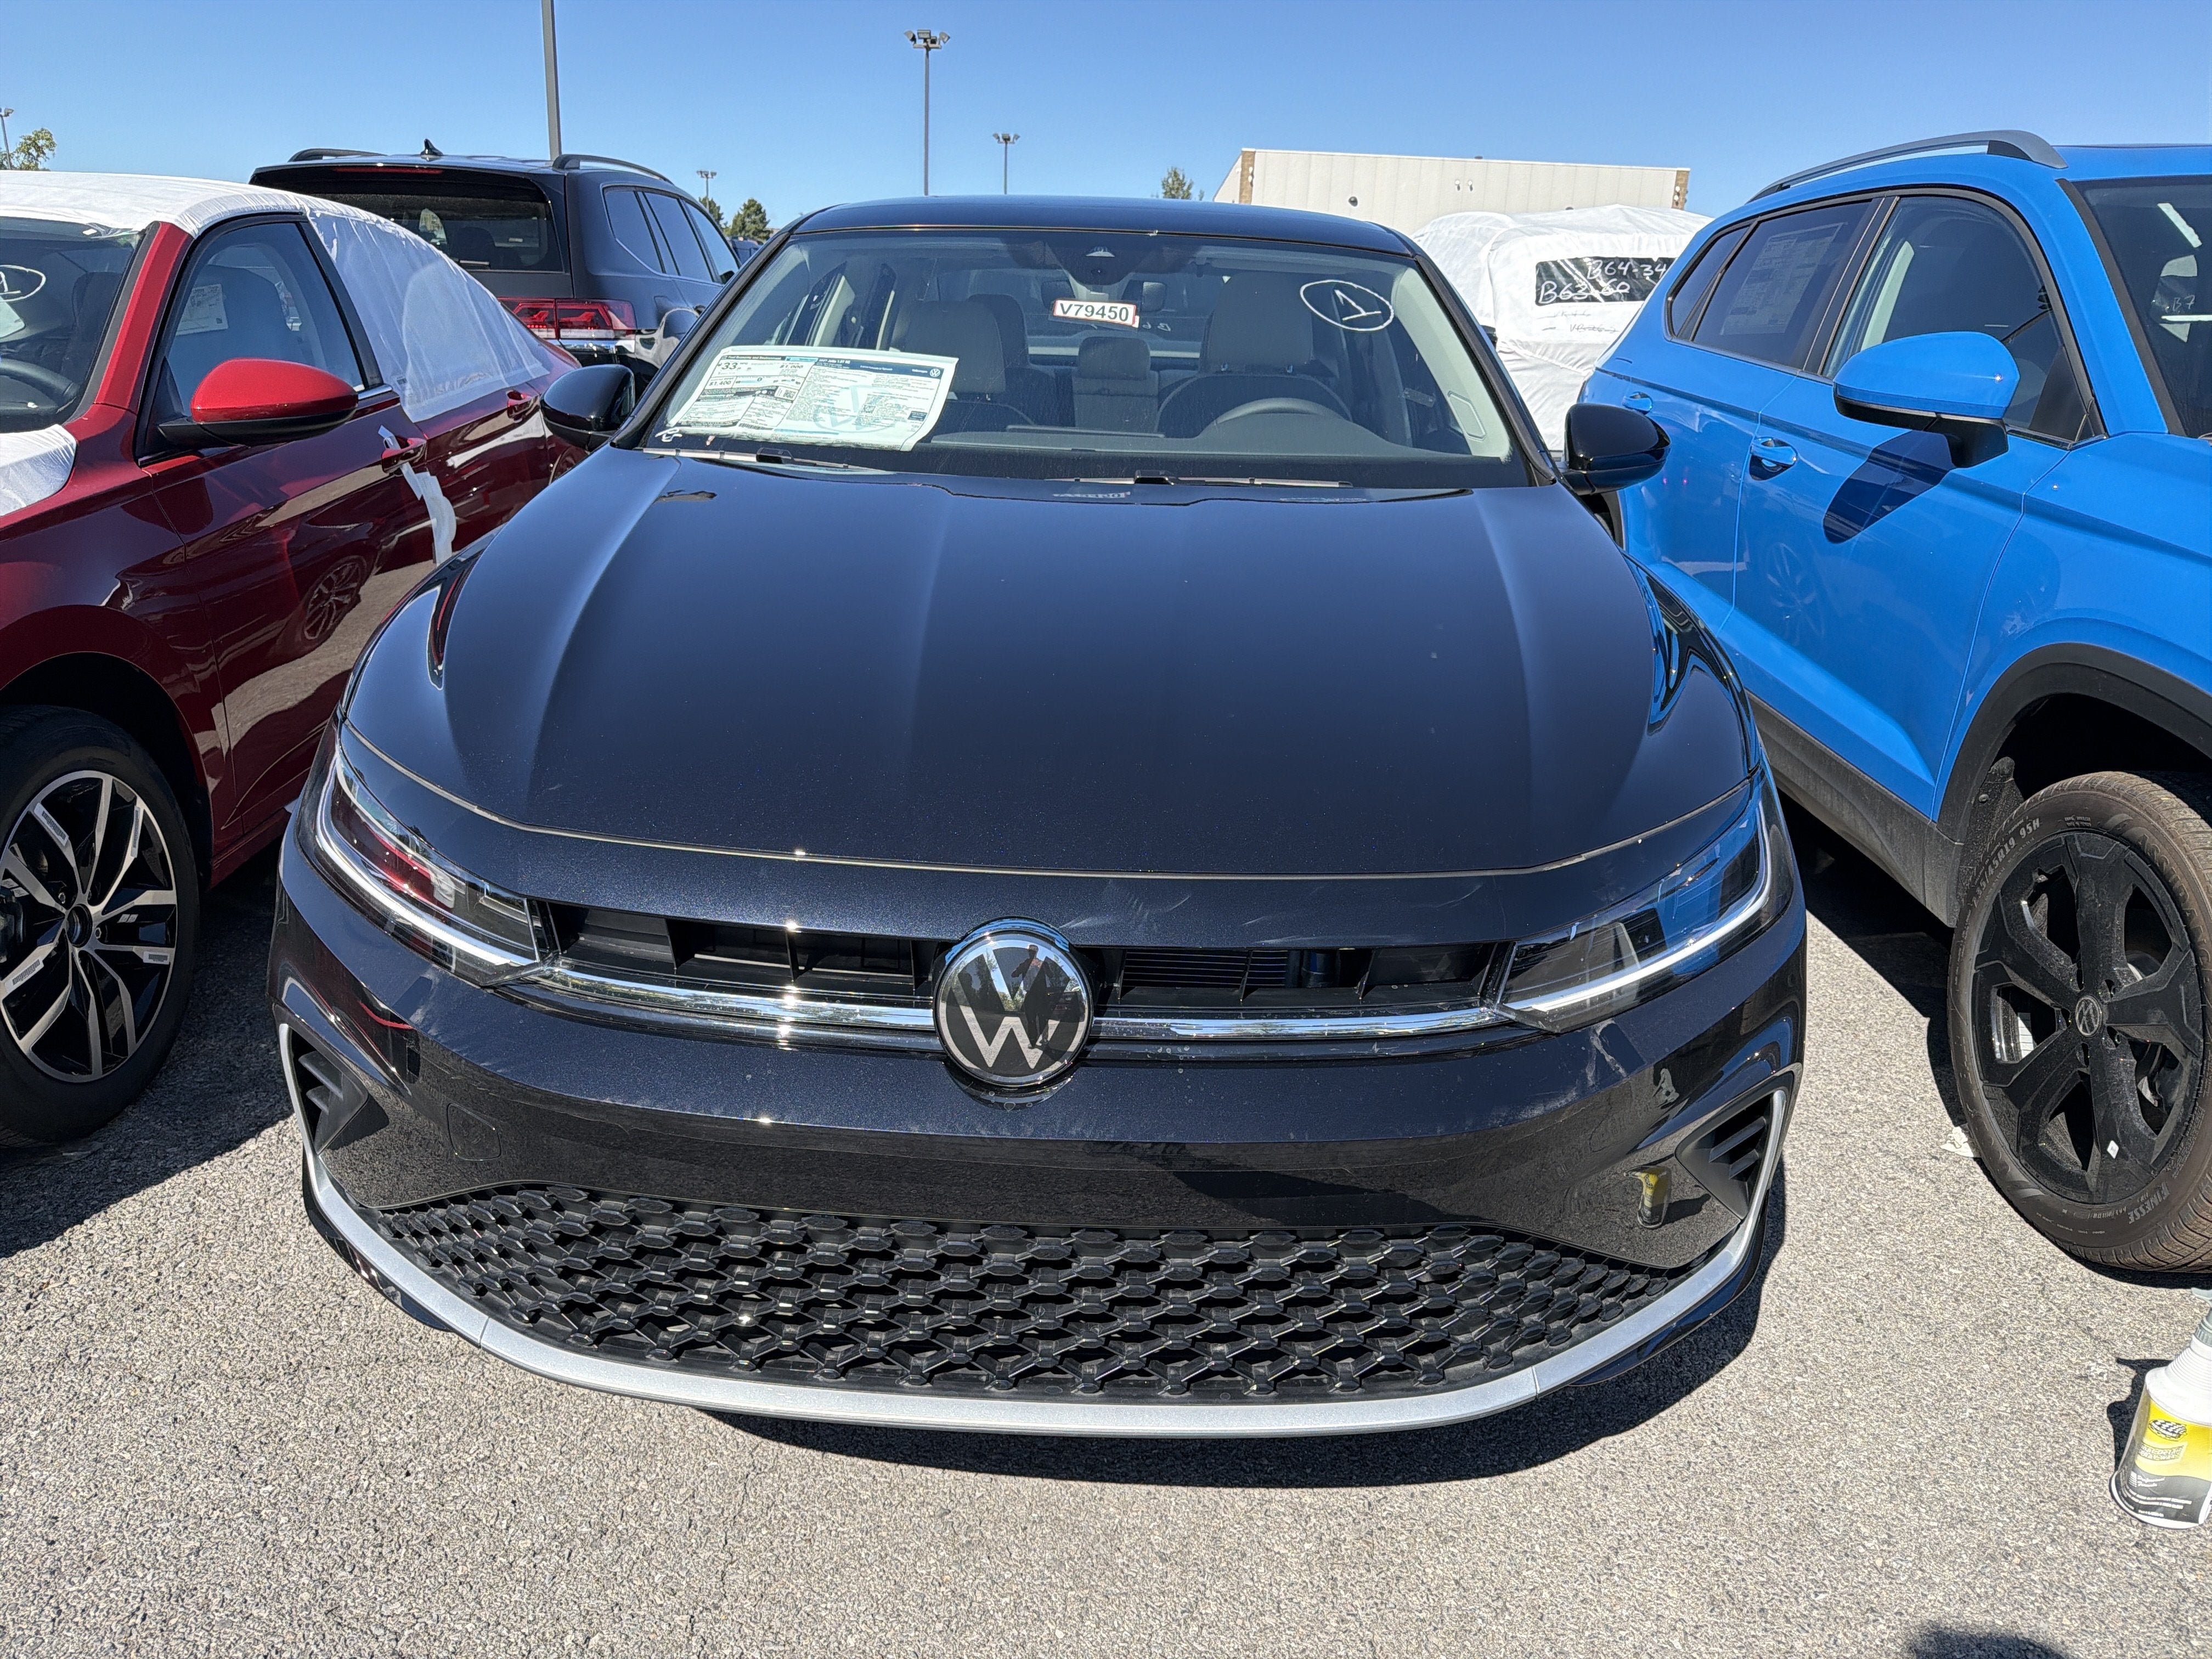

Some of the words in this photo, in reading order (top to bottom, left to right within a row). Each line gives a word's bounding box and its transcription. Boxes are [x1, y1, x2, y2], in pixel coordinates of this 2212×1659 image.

[1059, 303, 1129, 322] V79450
[2019, 818, 2040, 839] 95H
[2128, 1181, 2170, 1224] FINESSE
